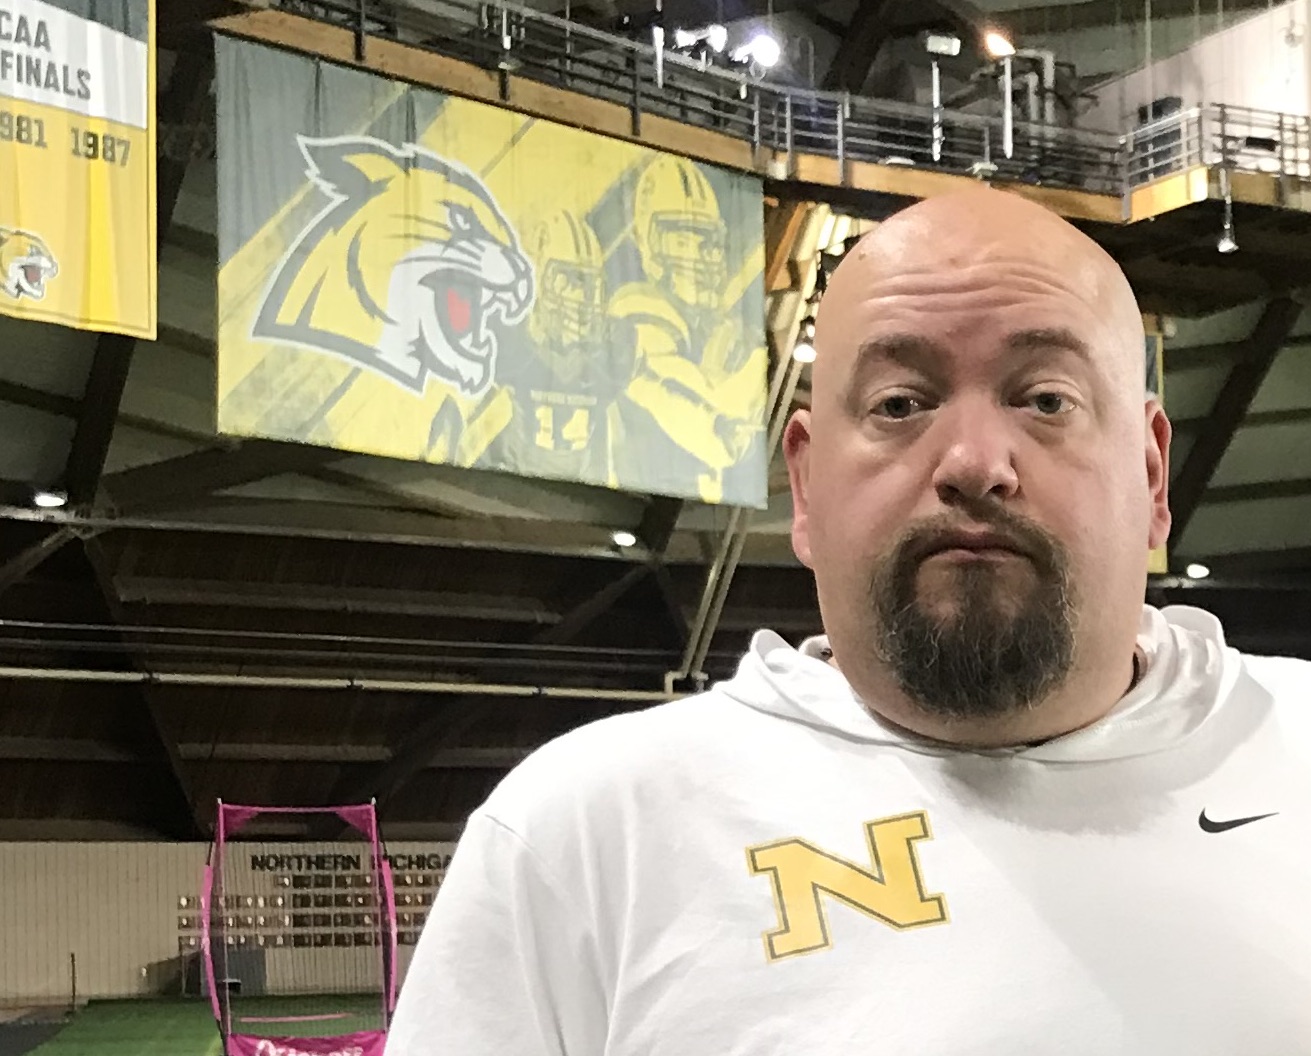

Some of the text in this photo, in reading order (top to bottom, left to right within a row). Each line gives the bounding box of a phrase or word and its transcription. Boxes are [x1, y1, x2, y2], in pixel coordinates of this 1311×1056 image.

[1, 49, 91, 100] FINALS
[70, 127, 131, 167] 1987
[535, 405, 589, 451] 14
[251, 854, 360, 872] NORTHERN
[745, 809, 951, 965] N
